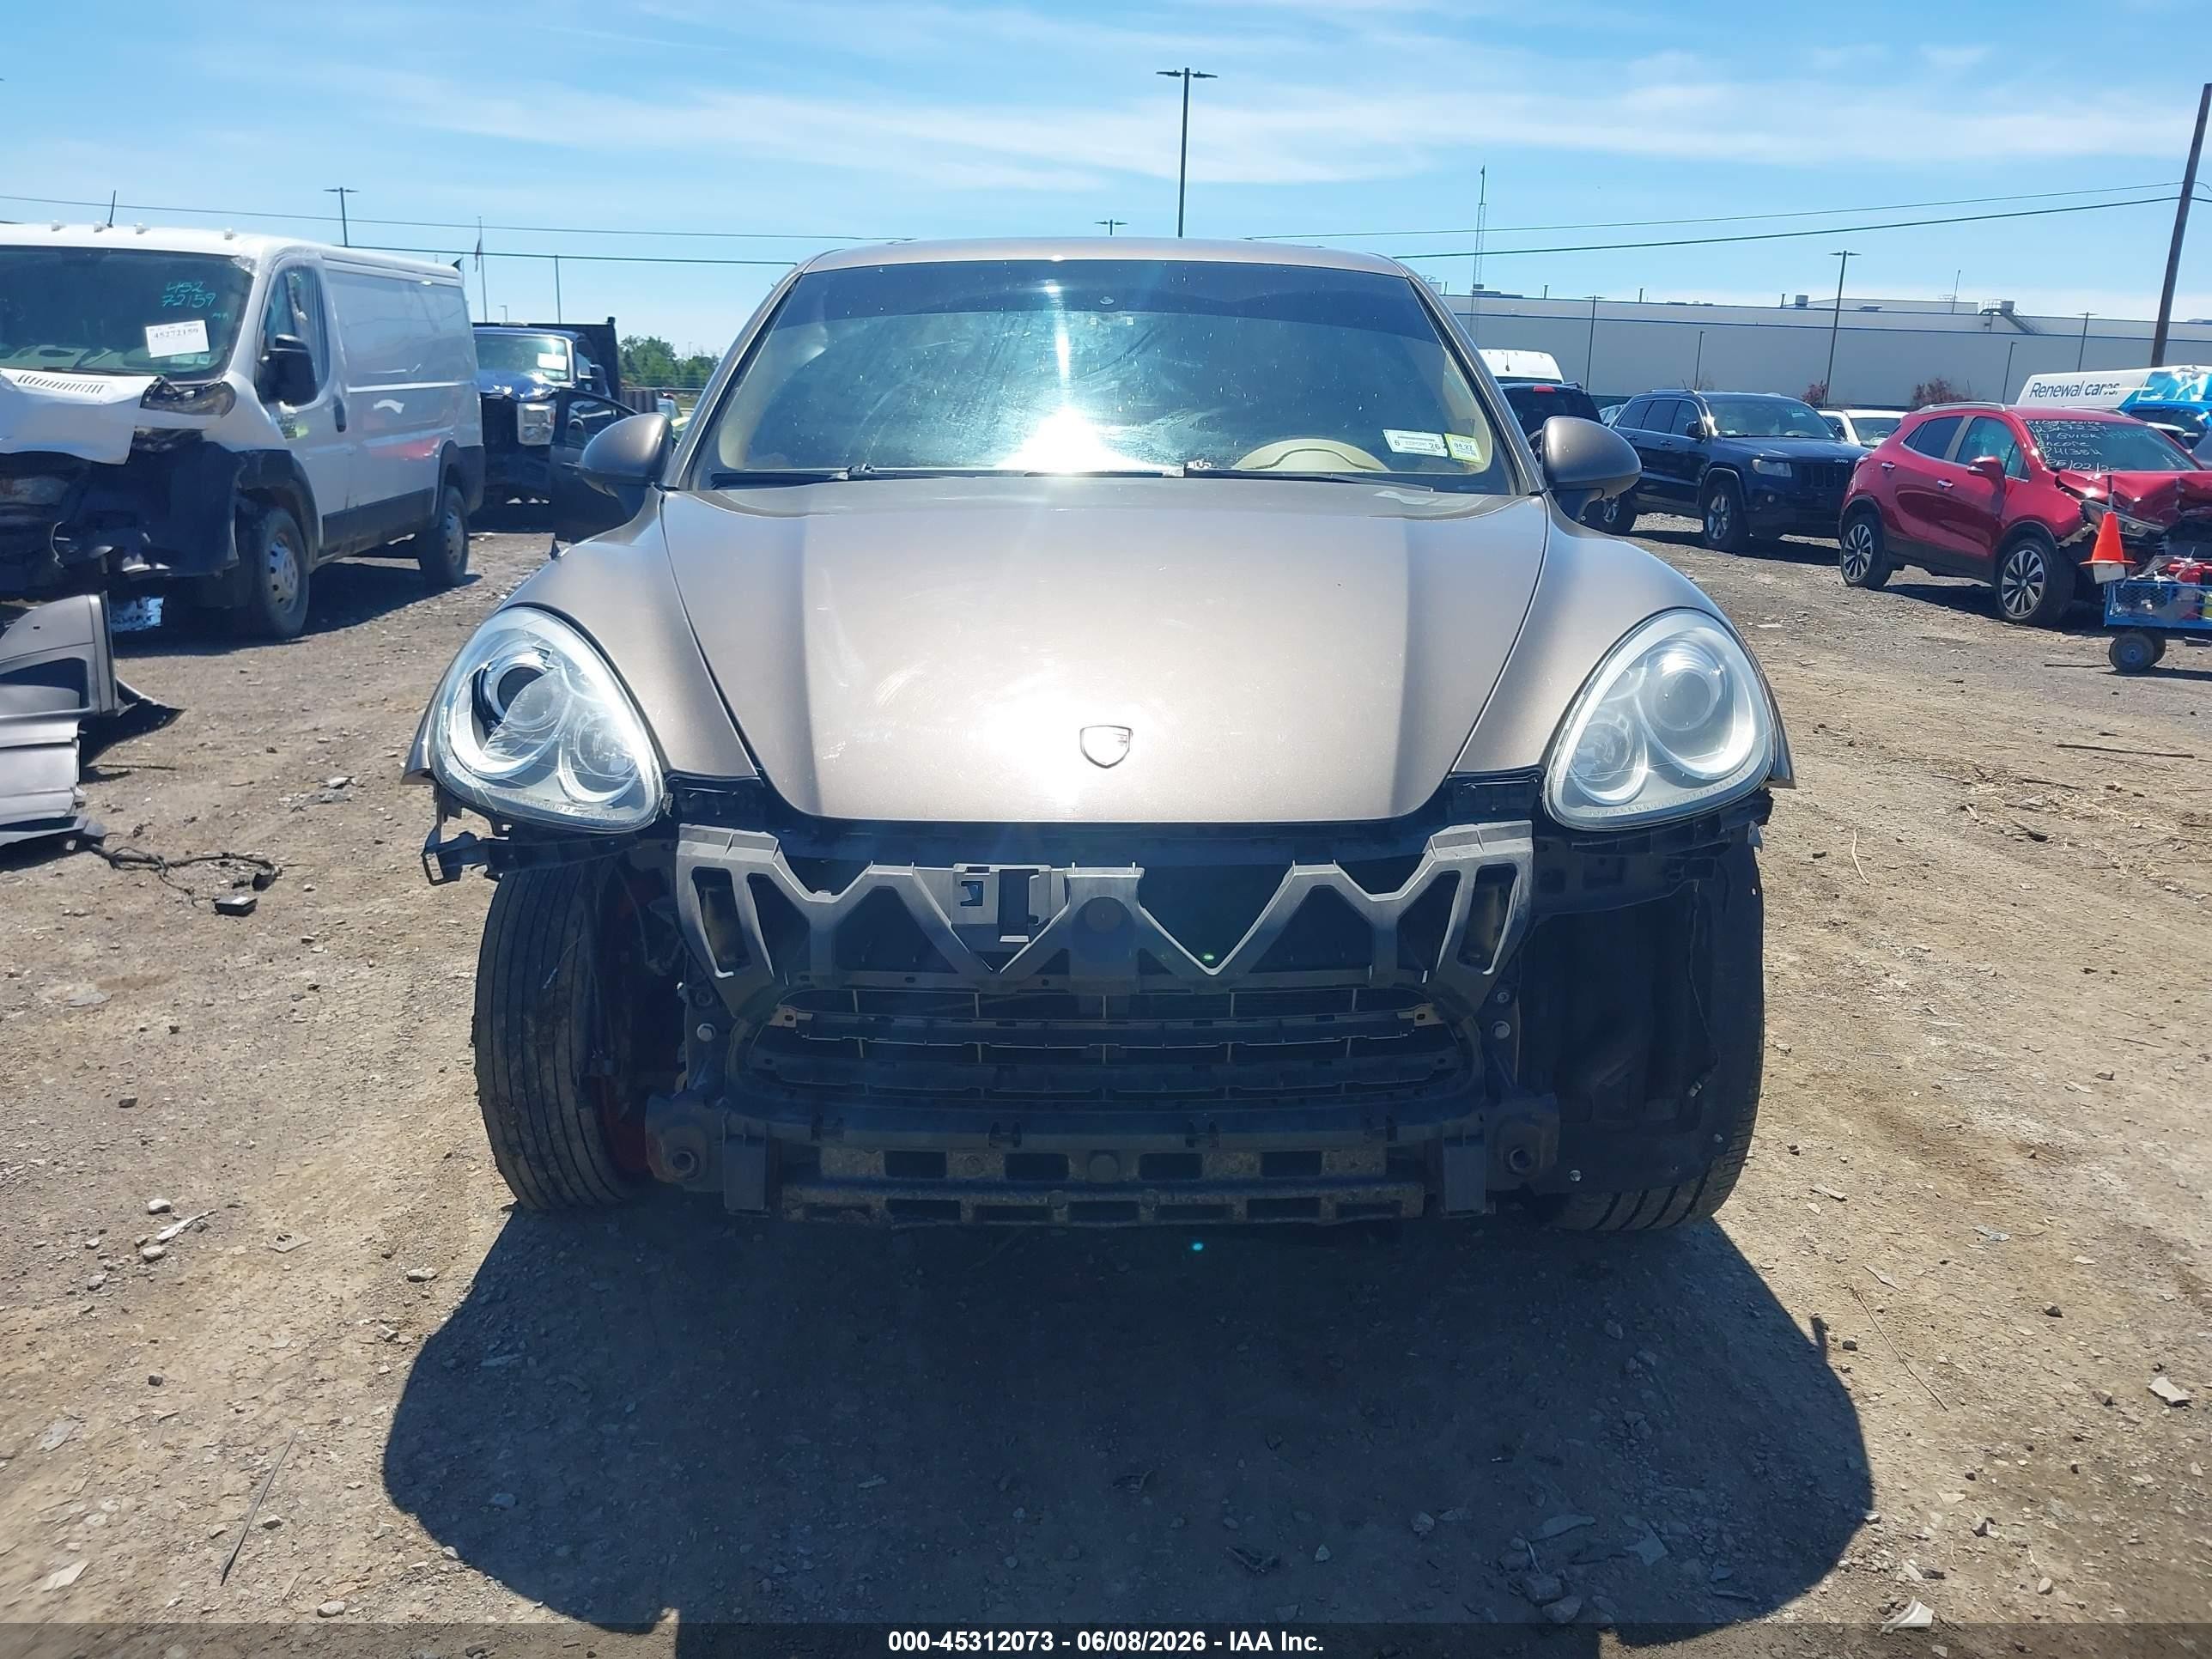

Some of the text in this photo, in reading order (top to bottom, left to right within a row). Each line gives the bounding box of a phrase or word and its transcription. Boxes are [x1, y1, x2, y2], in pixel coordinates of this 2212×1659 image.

[166, 282, 205, 294] 452
[162, 293, 216, 308] 72159
[2028, 380, 2085, 398] Renewal
